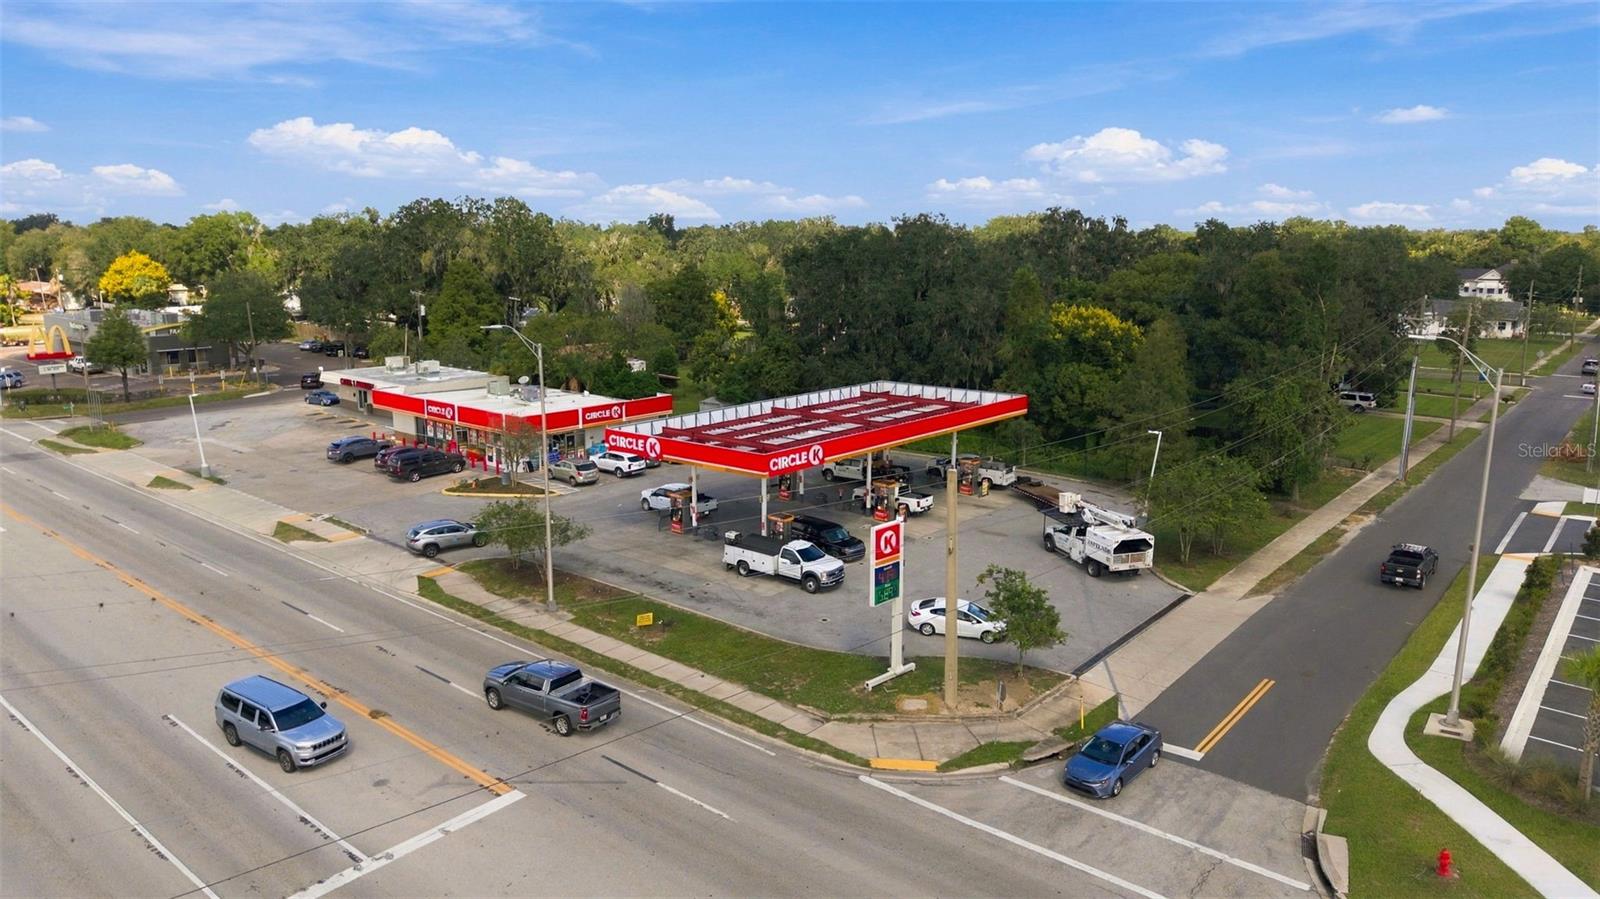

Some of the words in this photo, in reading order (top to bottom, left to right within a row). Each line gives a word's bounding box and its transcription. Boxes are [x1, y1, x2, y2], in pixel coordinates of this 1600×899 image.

[585, 410, 610, 420] CIRCLE
[611, 405, 620, 418] K
[609, 434, 645, 451] CIRCLE
[646, 438, 660, 457] K
[769, 453, 808, 472] CIRCLE
[808, 445, 823, 465] K
[881, 531, 896, 553] K
